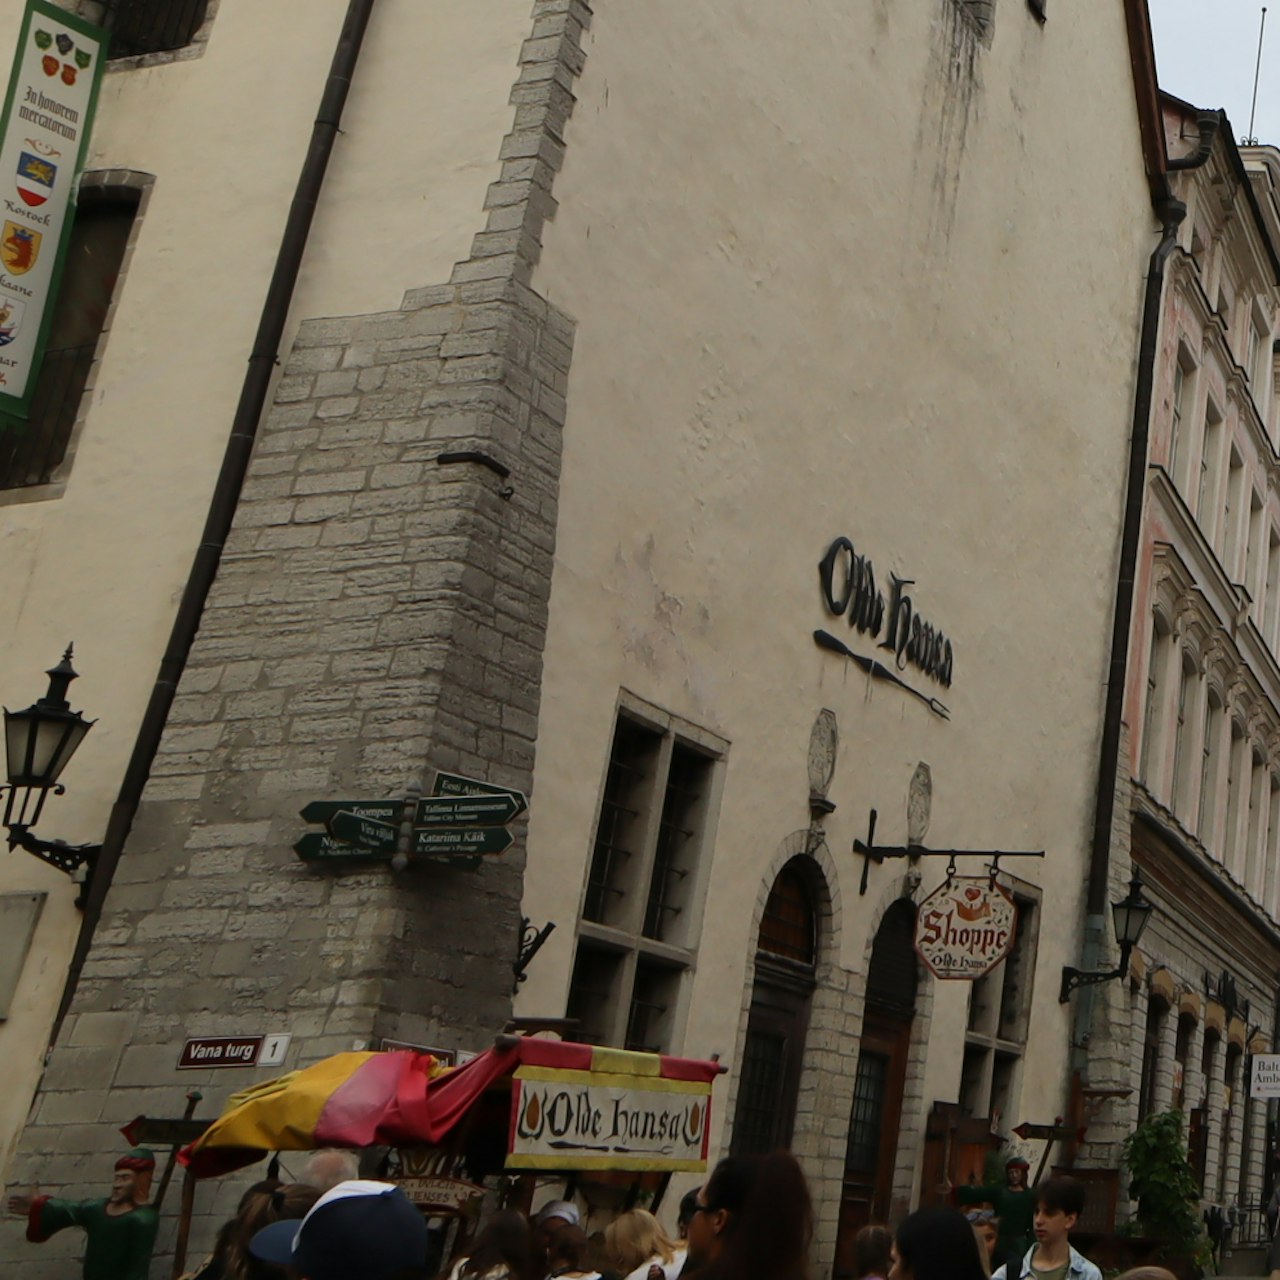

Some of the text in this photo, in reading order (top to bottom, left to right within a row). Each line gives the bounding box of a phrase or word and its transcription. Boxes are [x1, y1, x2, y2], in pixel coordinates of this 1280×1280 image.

[19, 106, 77, 141] mercatorum
[37, 90, 79, 124] honorem
[4, 199, 51, 227] Rostock
[352, 806, 394, 818] Toompea
[920, 909, 1008, 956] Shoppe
[190, 1040, 278, 1060] Vana turg 1
[546, 1086, 602, 1139] Olde
